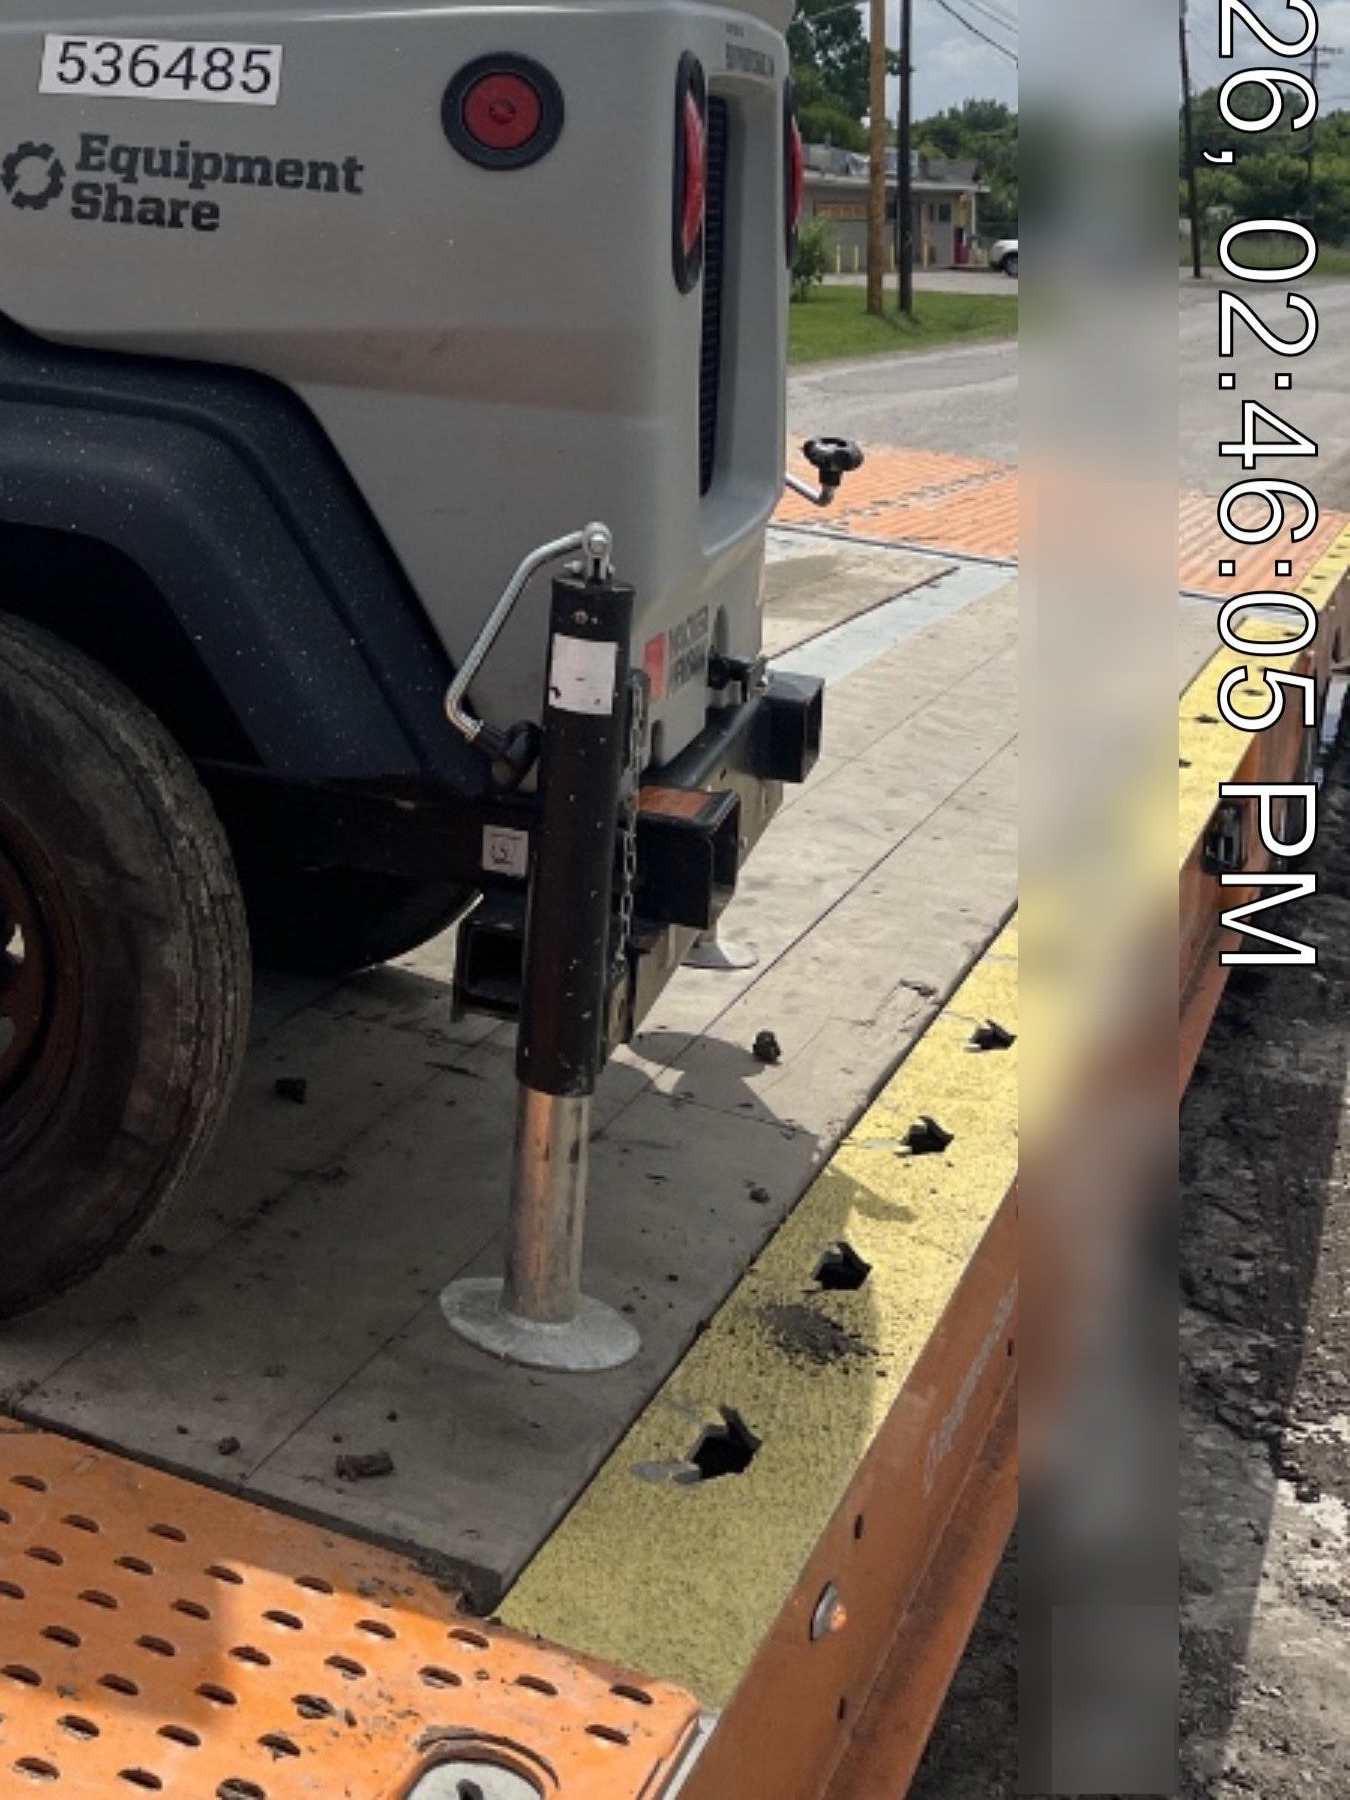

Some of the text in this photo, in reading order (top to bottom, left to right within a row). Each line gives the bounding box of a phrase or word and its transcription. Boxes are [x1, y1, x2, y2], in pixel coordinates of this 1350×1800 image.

[55, 40, 273, 94] 536485
[75, 132, 364, 195] Equipment
[70, 181, 221, 232] Share
